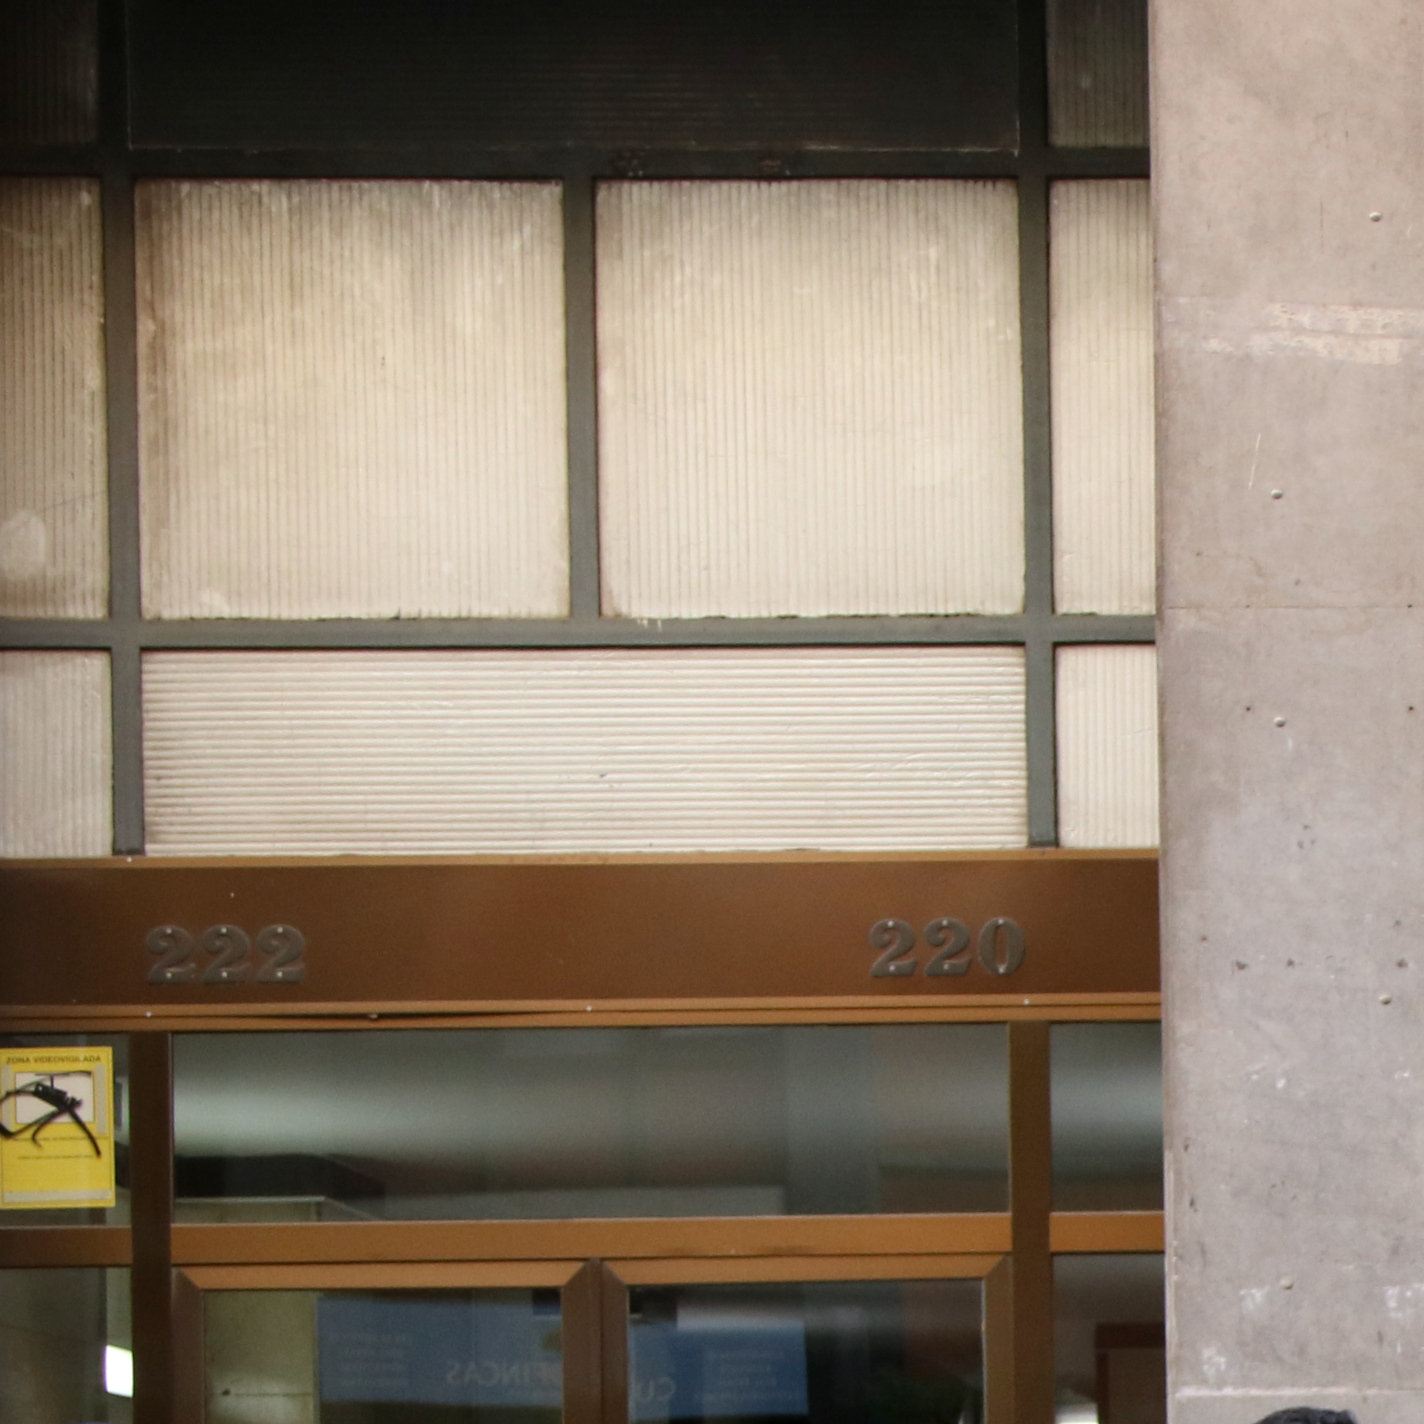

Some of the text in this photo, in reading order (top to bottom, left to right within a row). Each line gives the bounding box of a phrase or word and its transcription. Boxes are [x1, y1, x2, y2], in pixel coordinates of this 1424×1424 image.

[146, 924, 305, 984] 222
[869, 917, 1026, 977] 220
[6, 1056, 31, 1064] ZONA
